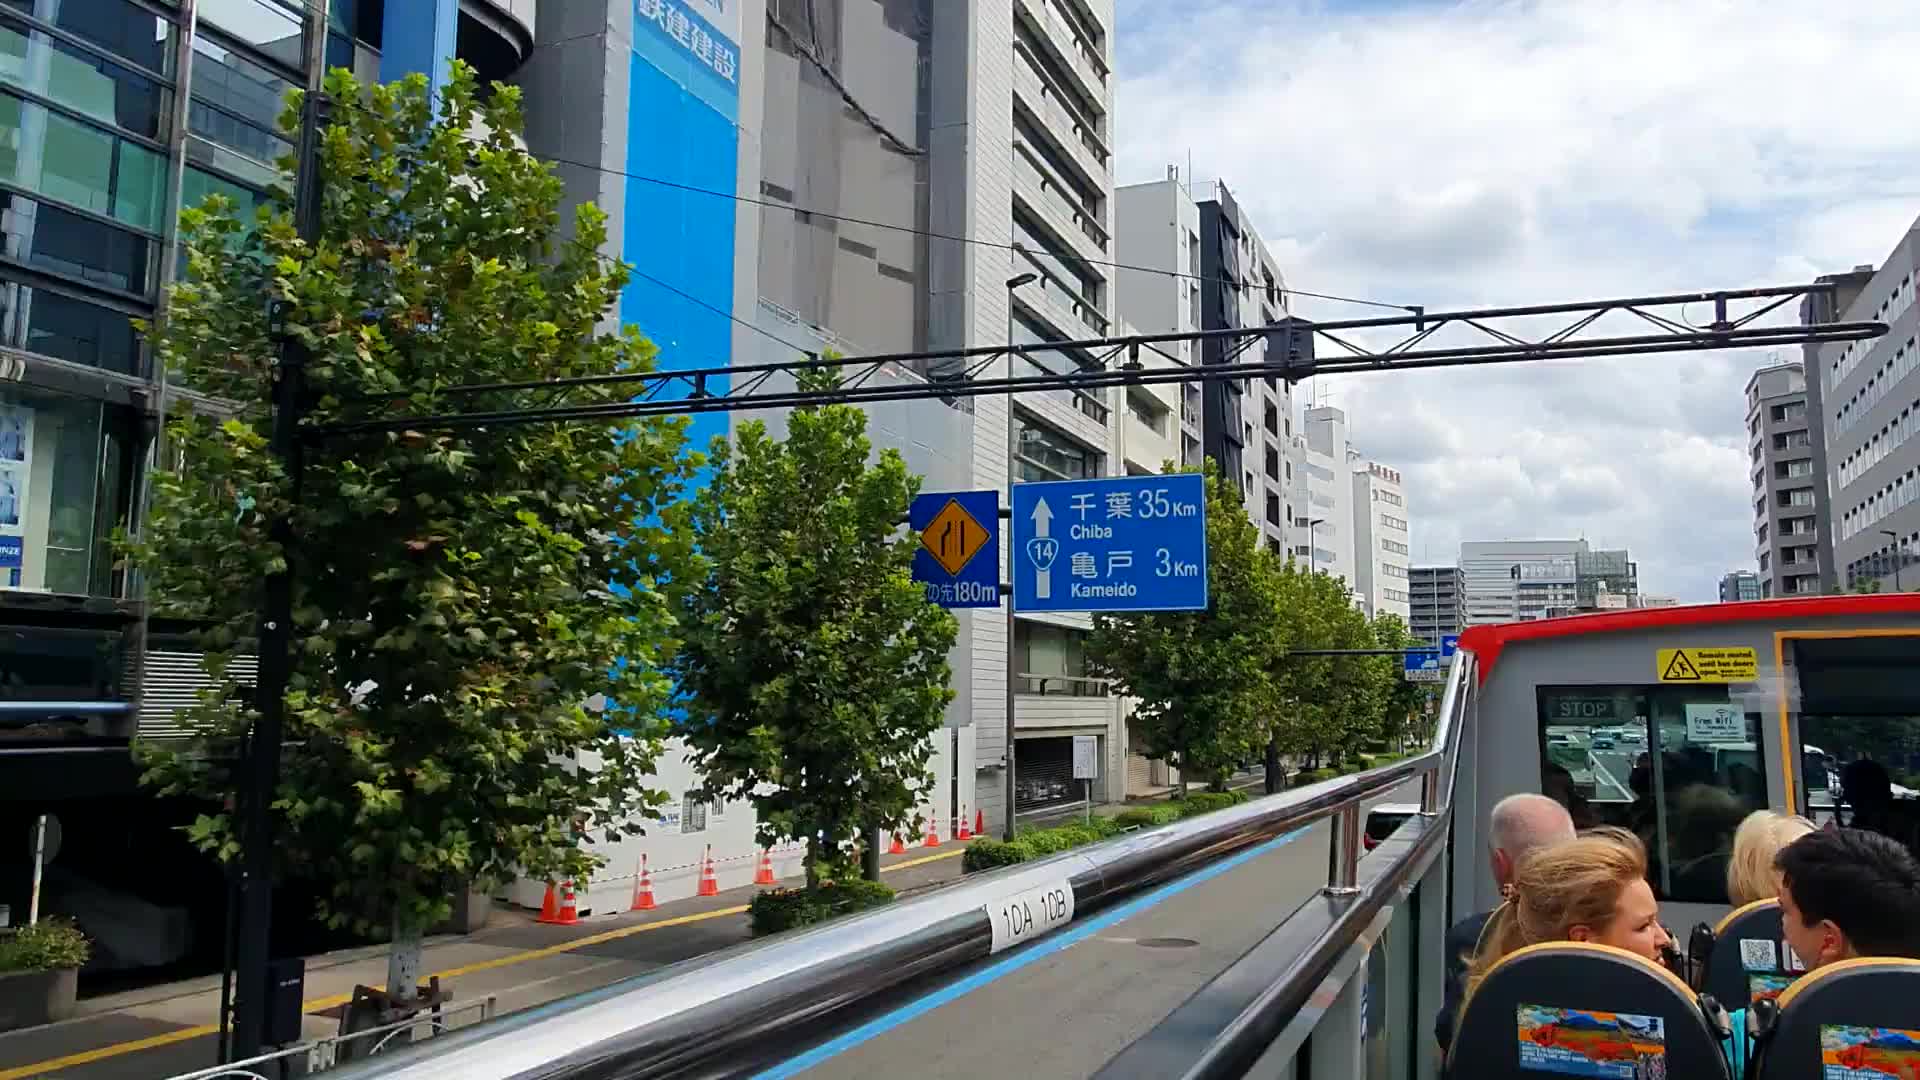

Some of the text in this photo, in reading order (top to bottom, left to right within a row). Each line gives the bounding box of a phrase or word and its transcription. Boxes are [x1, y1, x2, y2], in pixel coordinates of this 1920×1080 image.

[1070, 492, 1132, 520] 千葉
[1070, 525, 1112, 540] Chiba
[0, 546, 20, 555] NZE
[1034, 543, 1053, 561] 14
[1071, 551, 1133, 578] 亀戸
[927, 581, 996, 602] の先180m
[1071, 583, 1137, 598] Kameido
[1560, 702, 1606, 717] STOP
[1003, 889, 1067, 938] 10A 10B
